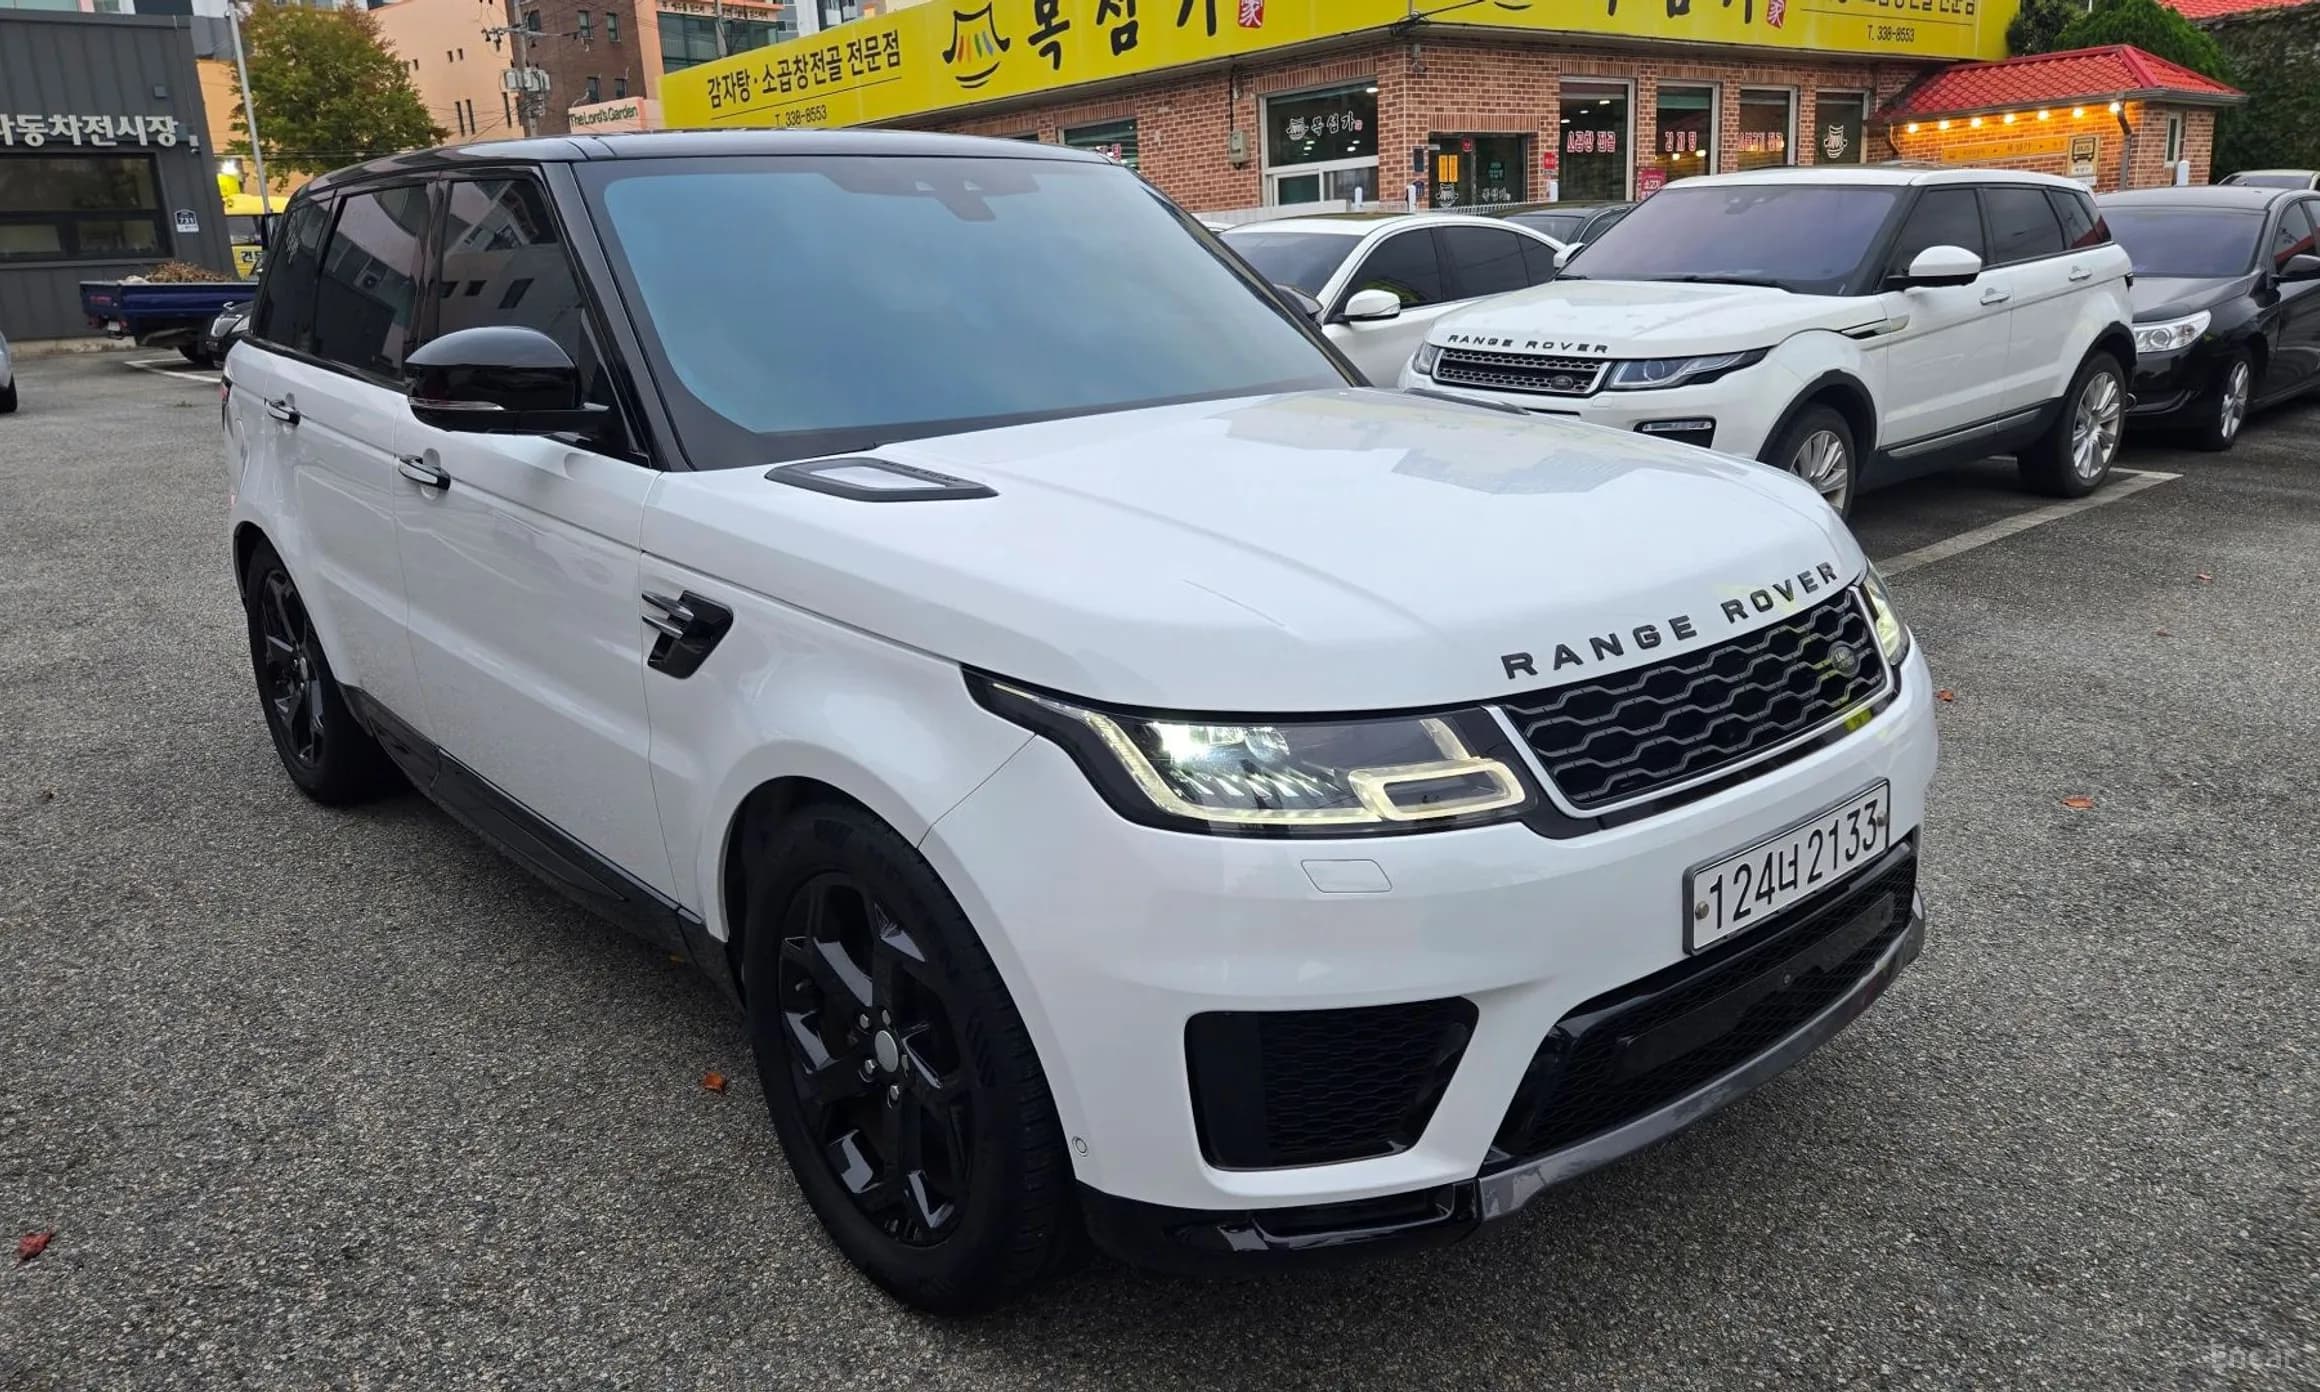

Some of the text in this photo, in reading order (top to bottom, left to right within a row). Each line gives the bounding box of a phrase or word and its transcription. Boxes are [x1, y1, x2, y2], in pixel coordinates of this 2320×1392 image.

[1877, 26, 1915, 42] 338-8553
[846, 29, 901, 76] 전문점
[608, 104, 638, 122] Garden
[785, 104, 827, 127] 338-8553
[1447, 334, 1608, 354] RANGE ROVER
[1500, 561, 1838, 680] RANGE ROVER
[1709, 799, 1879, 929] 124너 2133
